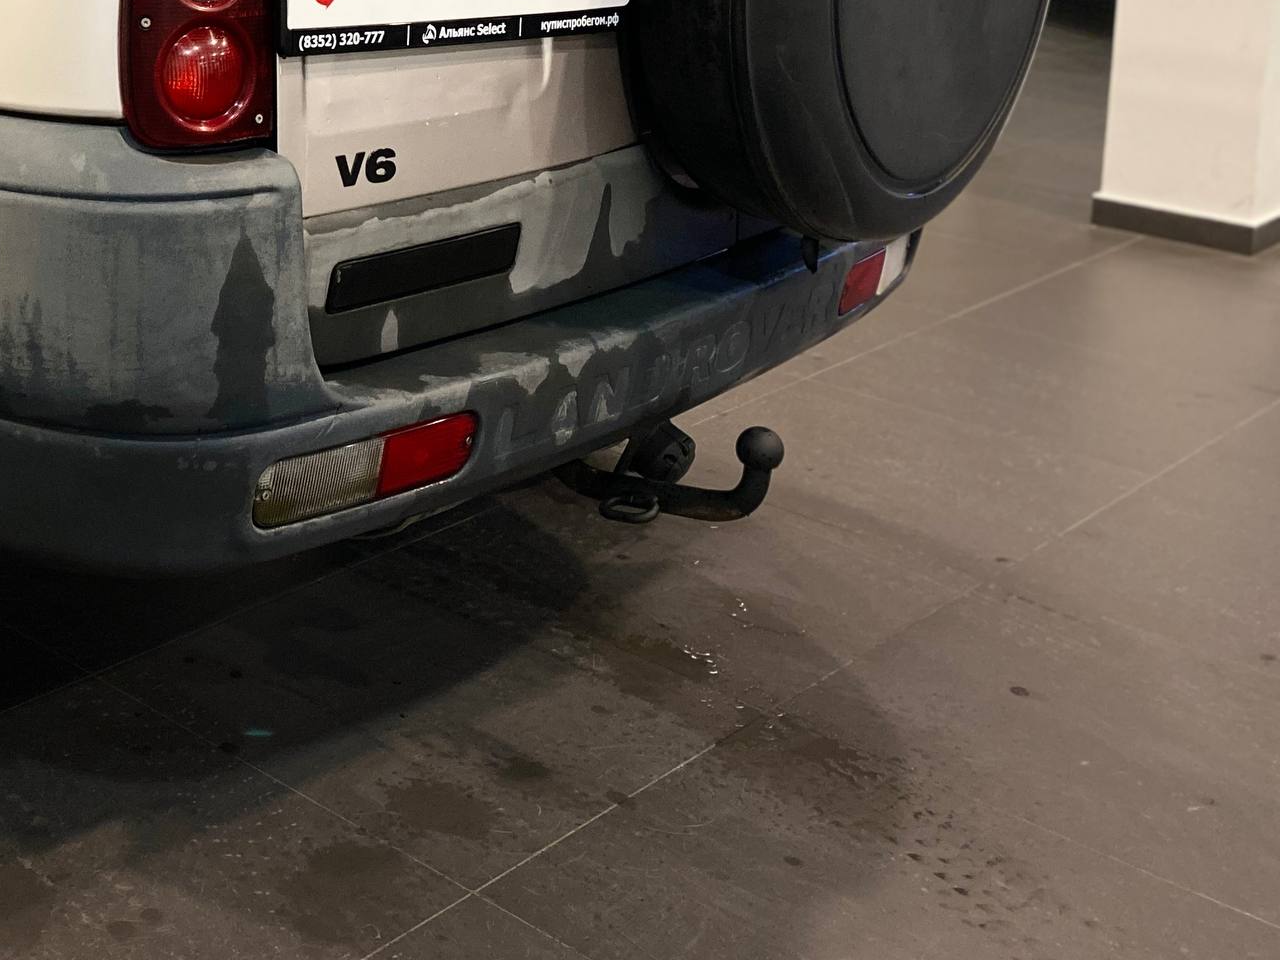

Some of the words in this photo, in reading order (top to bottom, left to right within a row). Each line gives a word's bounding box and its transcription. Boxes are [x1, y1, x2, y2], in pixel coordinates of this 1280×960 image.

[438, 23, 476, 39] Альянс
[476, 22, 507, 36] Select
[540, 12, 620, 32] куписпробегом.рф
[298, 34, 337, 52] (8352)
[339, 30, 385, 46] 320-777
[335, 147, 397, 188] V6
